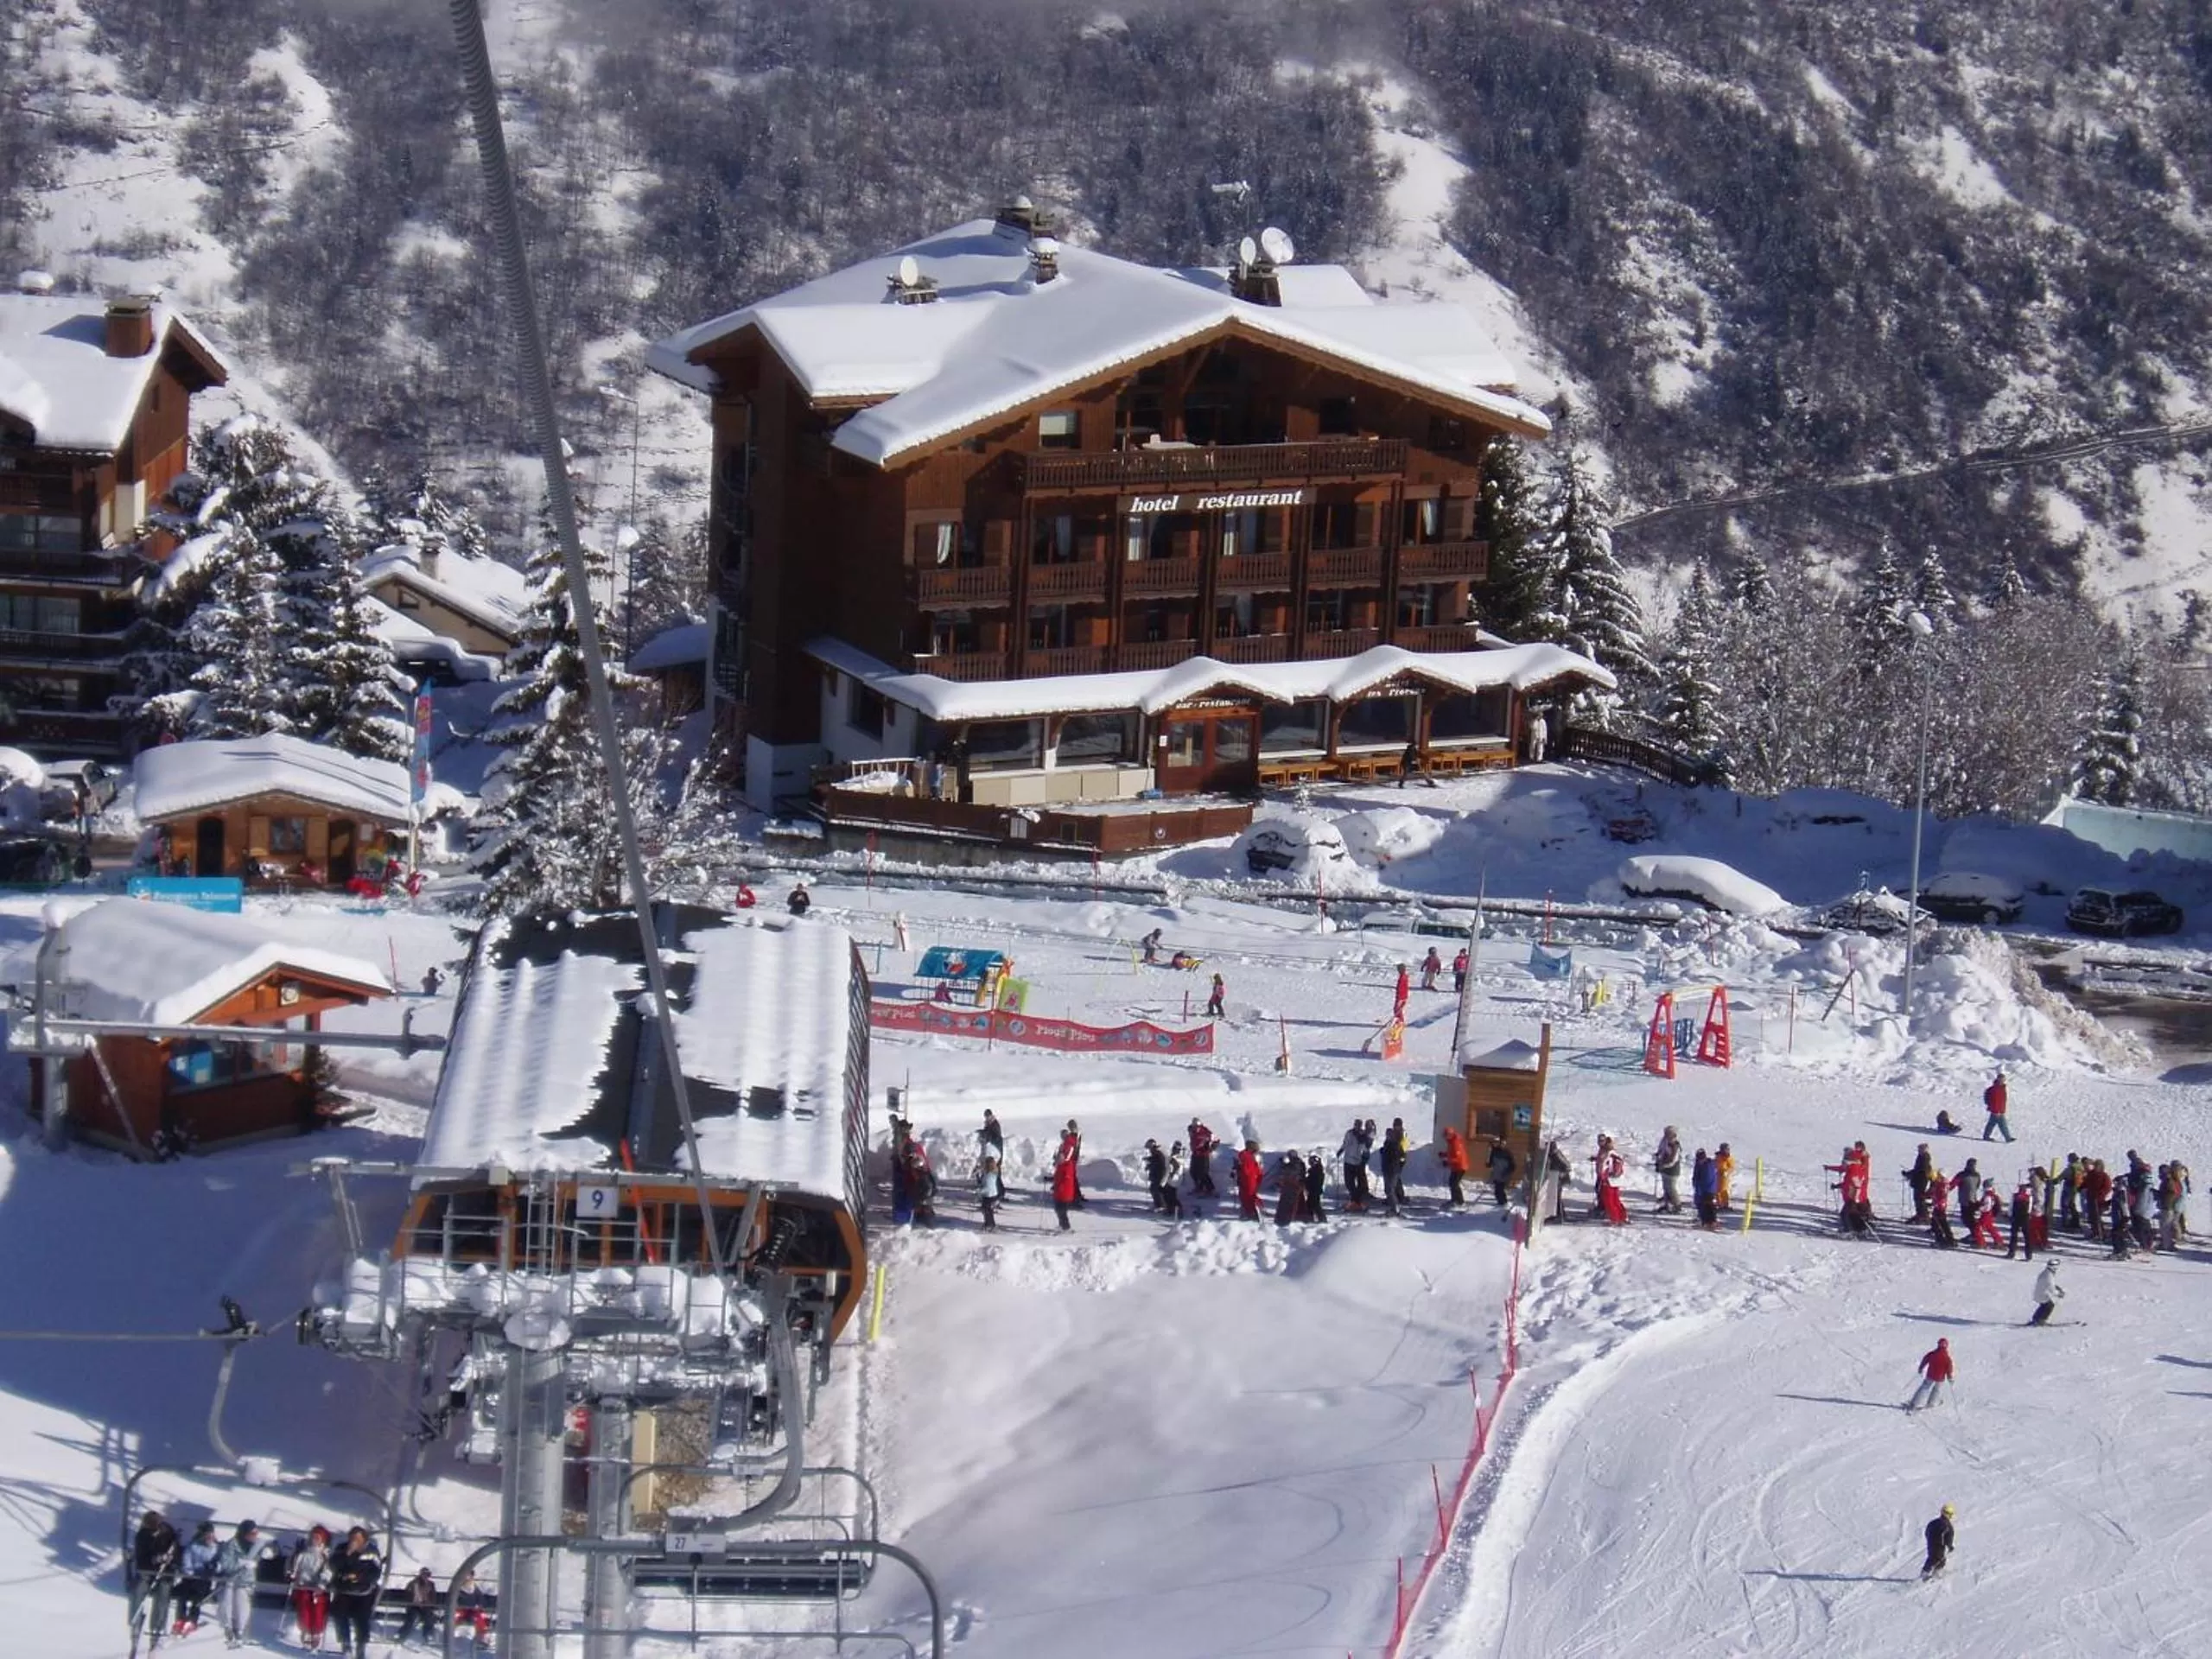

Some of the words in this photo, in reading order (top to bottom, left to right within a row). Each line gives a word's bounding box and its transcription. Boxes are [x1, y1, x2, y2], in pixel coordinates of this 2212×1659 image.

[1129, 495, 1179, 512] hotel
[1197, 490, 1302, 509] restaurant
[592, 1189, 603, 1210] 9
[675, 1536, 686, 1549] 27
